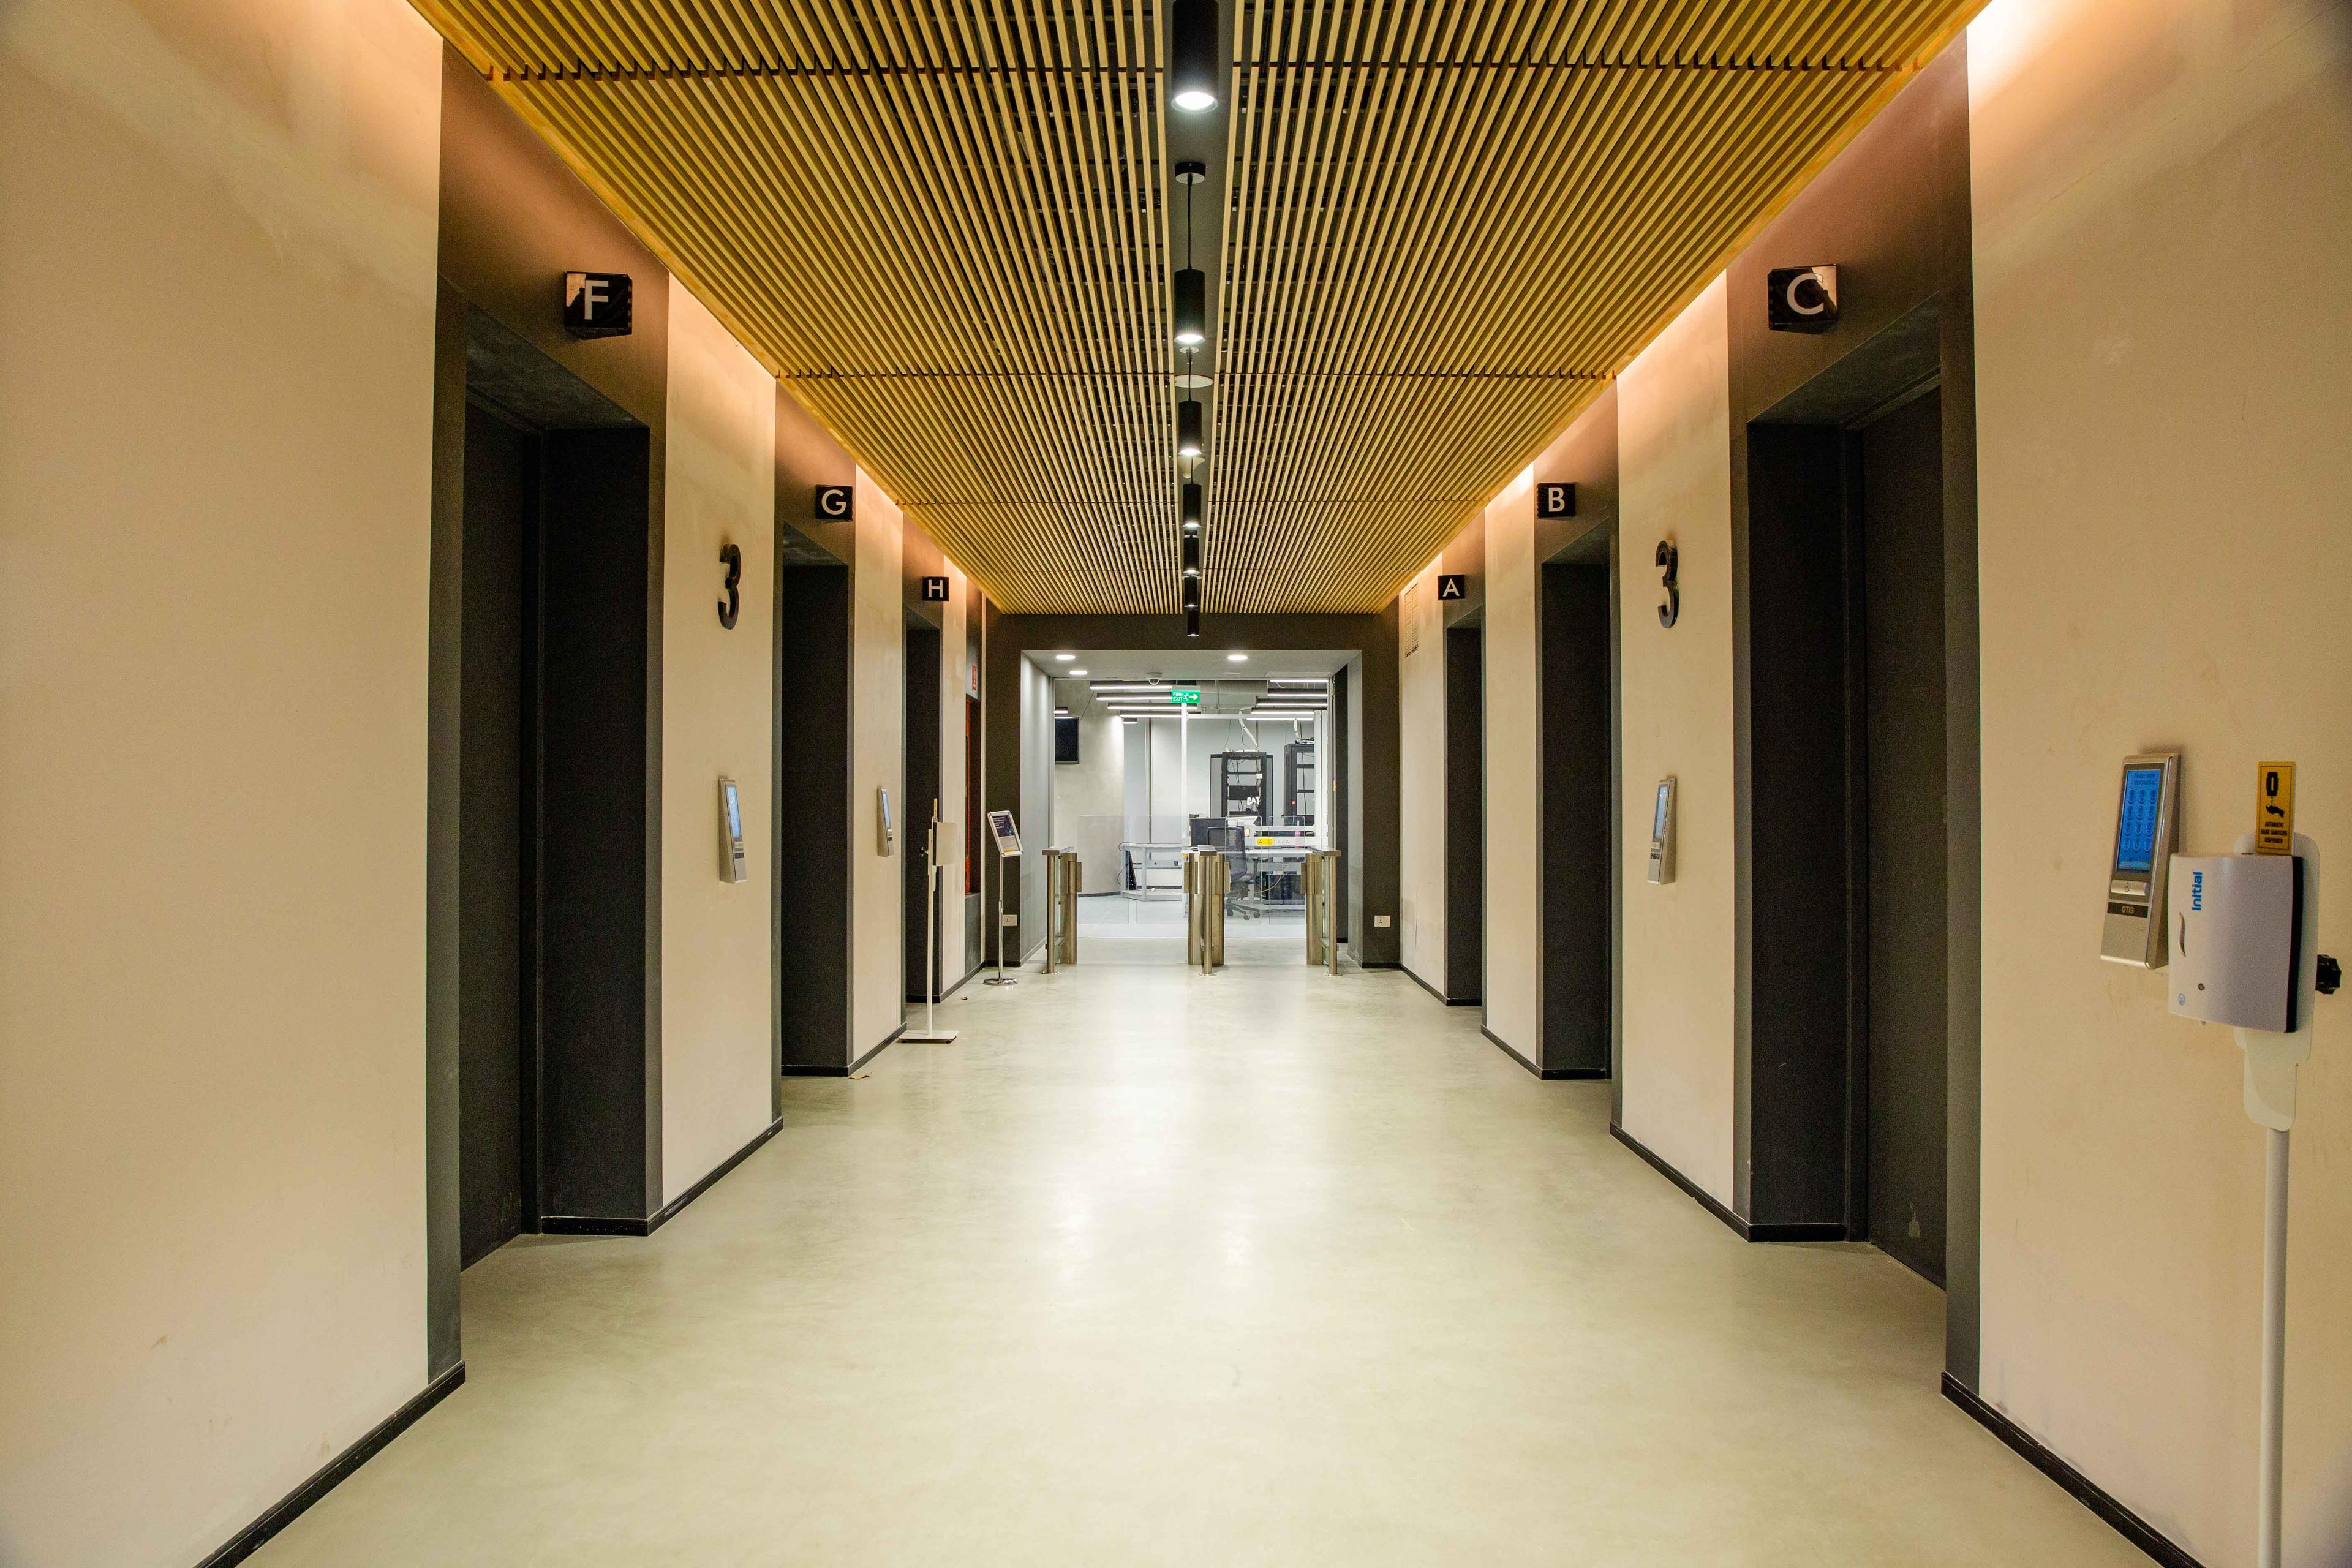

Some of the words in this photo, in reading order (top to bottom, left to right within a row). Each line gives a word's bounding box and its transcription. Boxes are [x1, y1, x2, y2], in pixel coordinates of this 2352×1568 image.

[584, 280, 608, 320] F
[1787, 273, 1824, 315] C
[821, 489, 846, 514] G
[1548, 487, 1565, 512] B
[718, 543, 742, 630] 3
[928, 579, 943, 598] H
[1442, 578, 1460, 597] A
[1656, 540, 1679, 628] 3
[1246, 796, 1261, 805] CAT
[2191, 871, 2203, 911] Initial
[2121, 905, 2135, 914] OTIS
